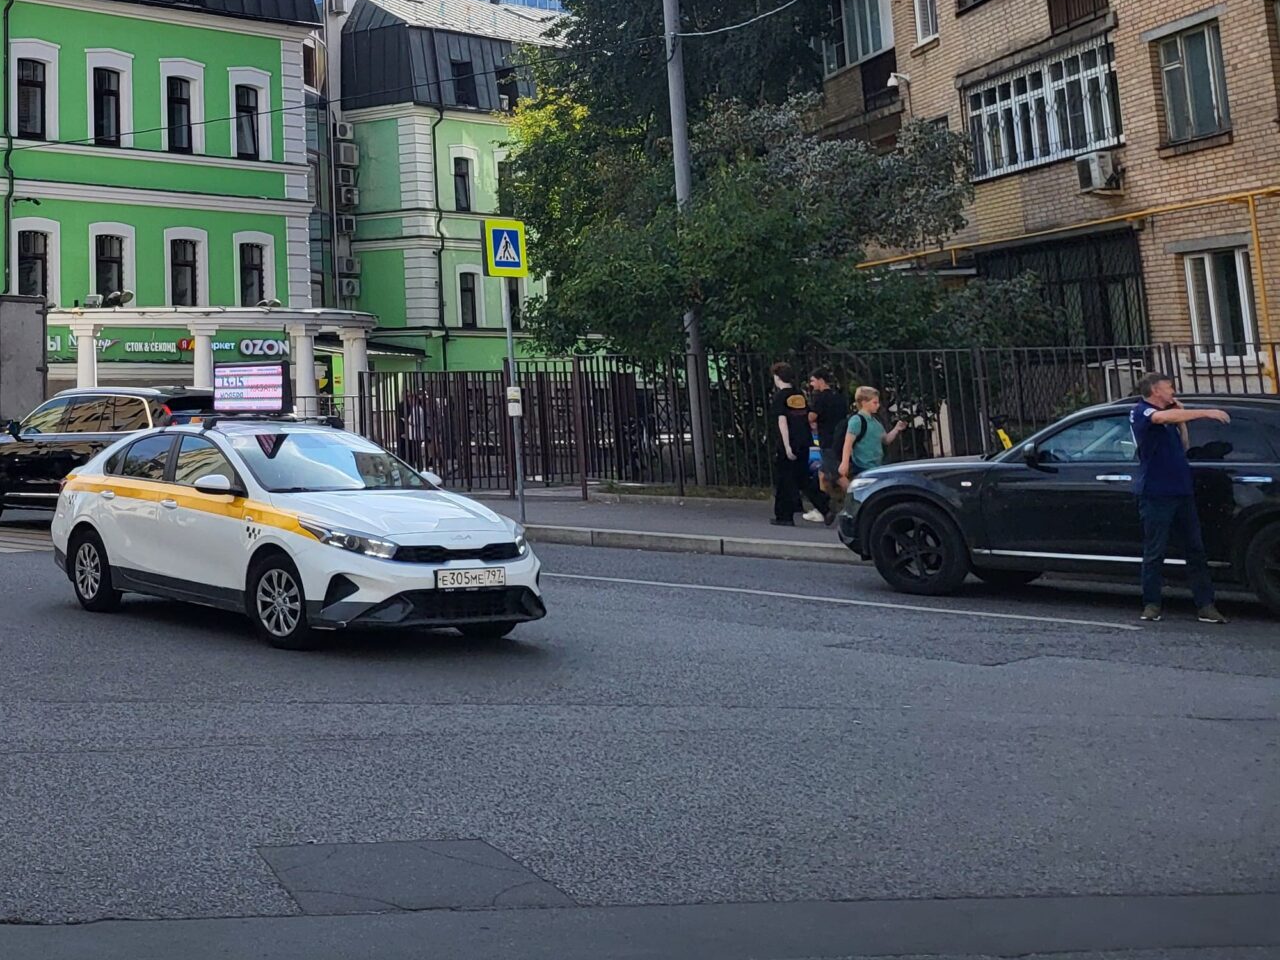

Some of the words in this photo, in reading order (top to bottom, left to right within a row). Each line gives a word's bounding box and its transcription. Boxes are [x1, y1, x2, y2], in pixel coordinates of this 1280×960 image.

[47, 335, 61, 351] Ы
[125, 342, 143, 352] СТОК
[144, 342, 150, 352] &
[150, 342, 177, 353] СЕКОНД
[210, 342, 236, 351] ркет
[240, 339, 290, 355] OZON
[441, 572, 484, 586] Е305МЕ
[485, 570, 502, 580] 797
